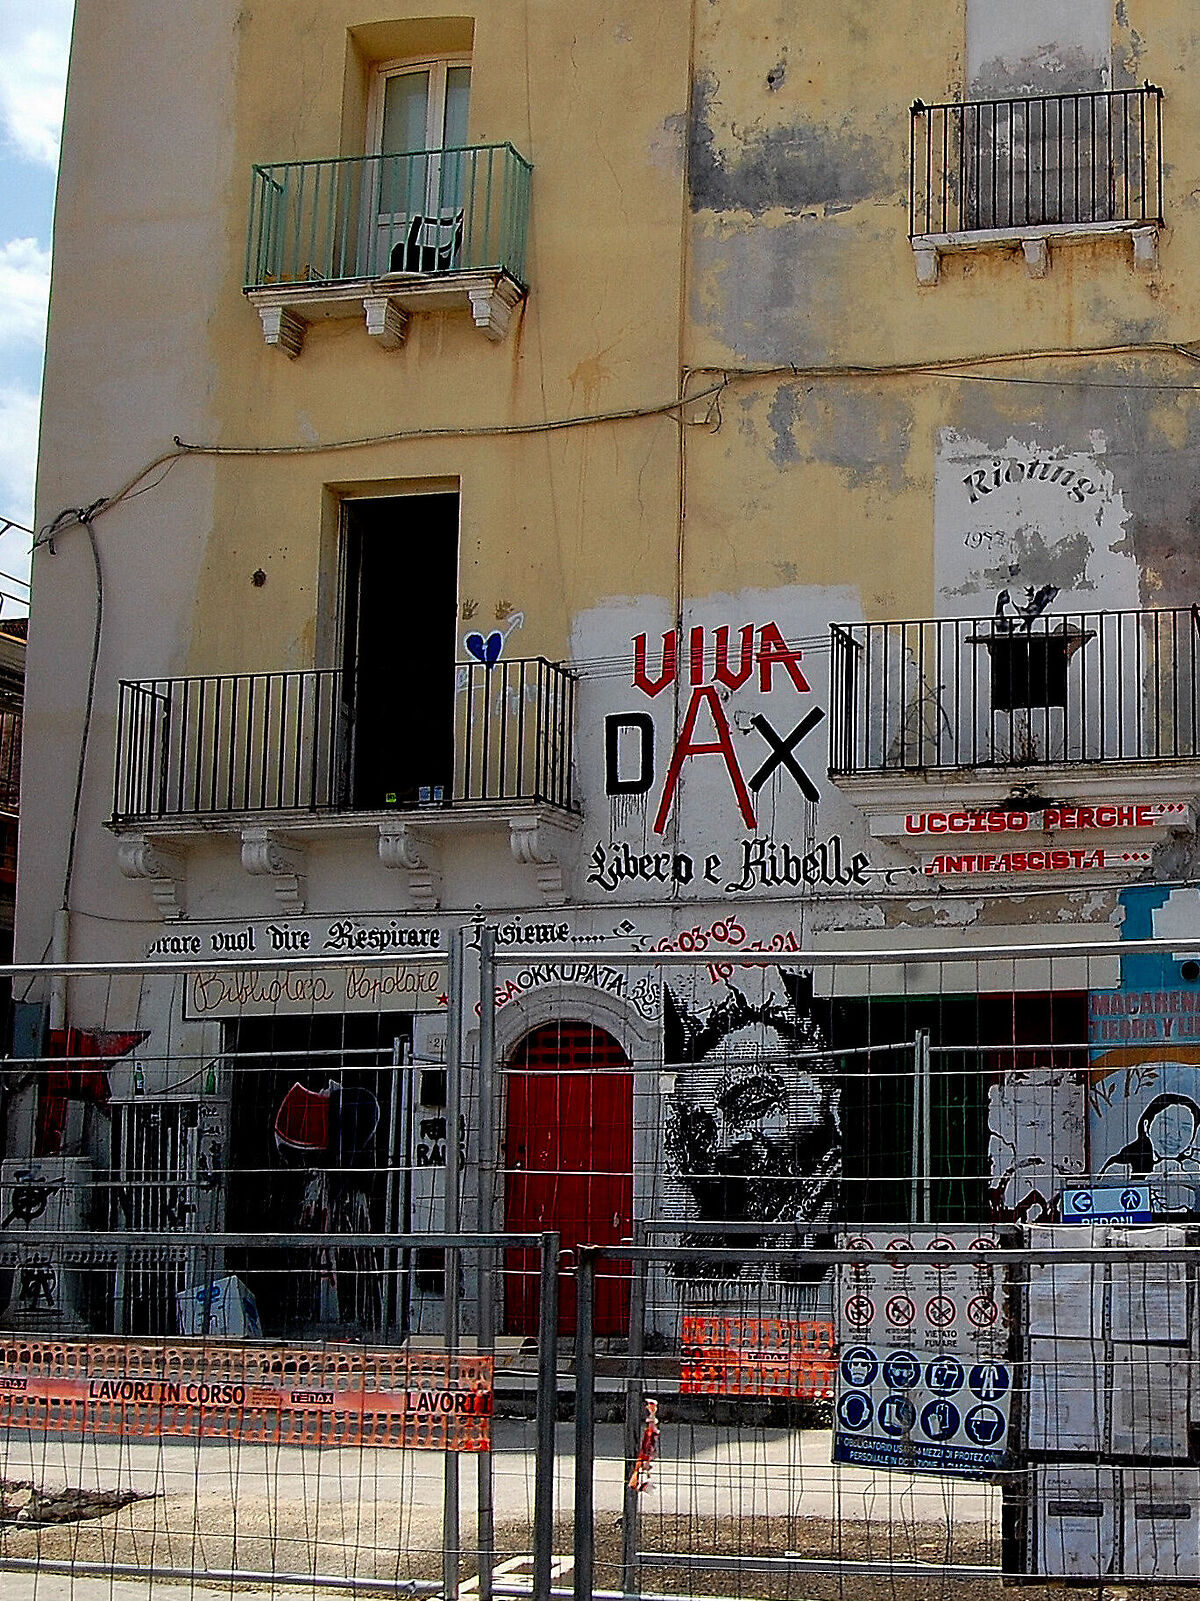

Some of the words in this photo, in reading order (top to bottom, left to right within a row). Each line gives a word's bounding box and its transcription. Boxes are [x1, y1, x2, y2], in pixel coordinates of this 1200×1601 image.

[962, 458, 1098, 504] Rioting
[630, 621, 812, 699] VIVA
[604, 684, 826, 835] DAX
[905, 812, 1029, 834] UCCISO
[586, 842, 694, 893] Libero
[703, 852, 723, 885] e
[924, 849, 1105, 874] ANTIFASCISTA
[265, 923, 311, 951] dire
[323, 920, 440, 952] Respirare
[1162, 1017, 1174, 1038] Y
[924, 1330, 958, 1339] VIETATO
[924, 1339, 958, 1348] FUMARE
[89, 1380, 157, 1401] LAVORI
[159, 1382, 181, 1403] IN
[185, 1383, 246, 1405] CORSO
[407, 1391, 476, 1413] LAVORI
